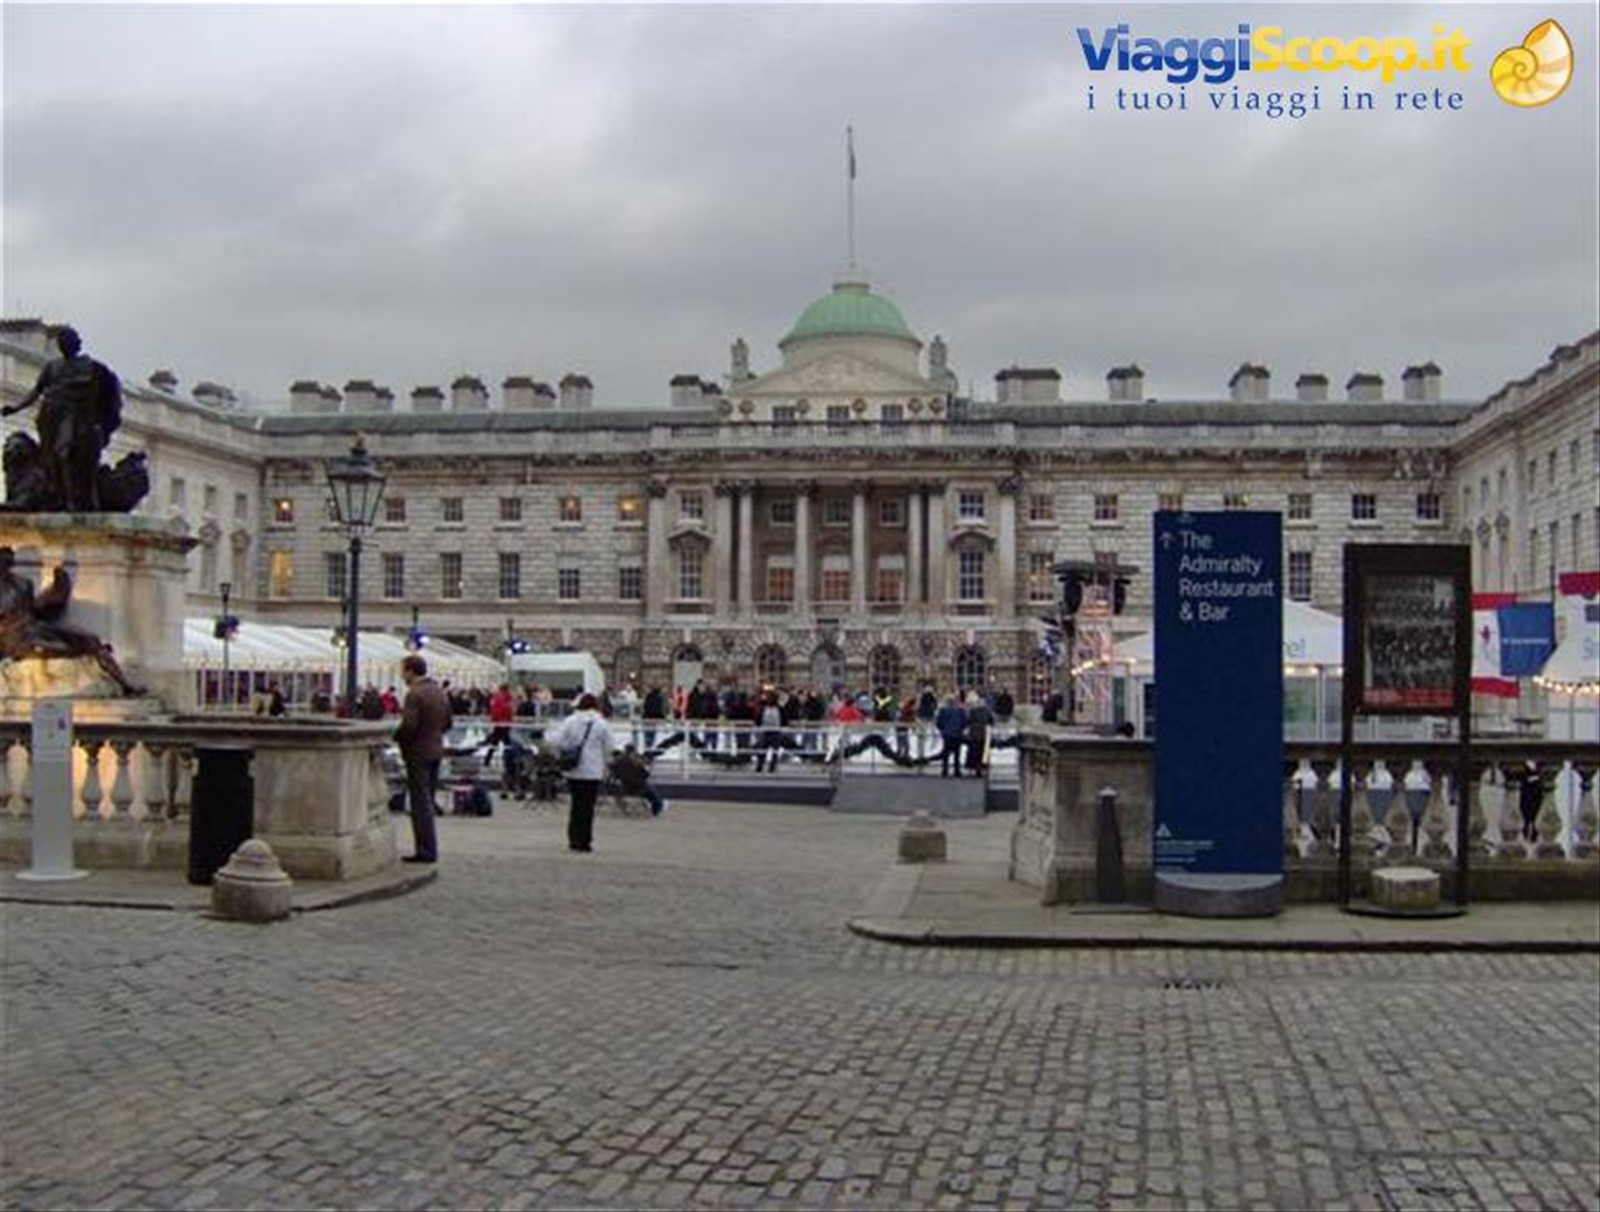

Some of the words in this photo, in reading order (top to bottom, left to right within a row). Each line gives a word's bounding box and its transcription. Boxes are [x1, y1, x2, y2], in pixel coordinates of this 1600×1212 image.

[1179, 530, 1212, 550] The
[1179, 553, 1262, 577] Admiralty
[1179, 578, 1275, 598] Restaurant
[1179, 600, 1193, 621] &
[1198, 601, 1230, 621] Bar
